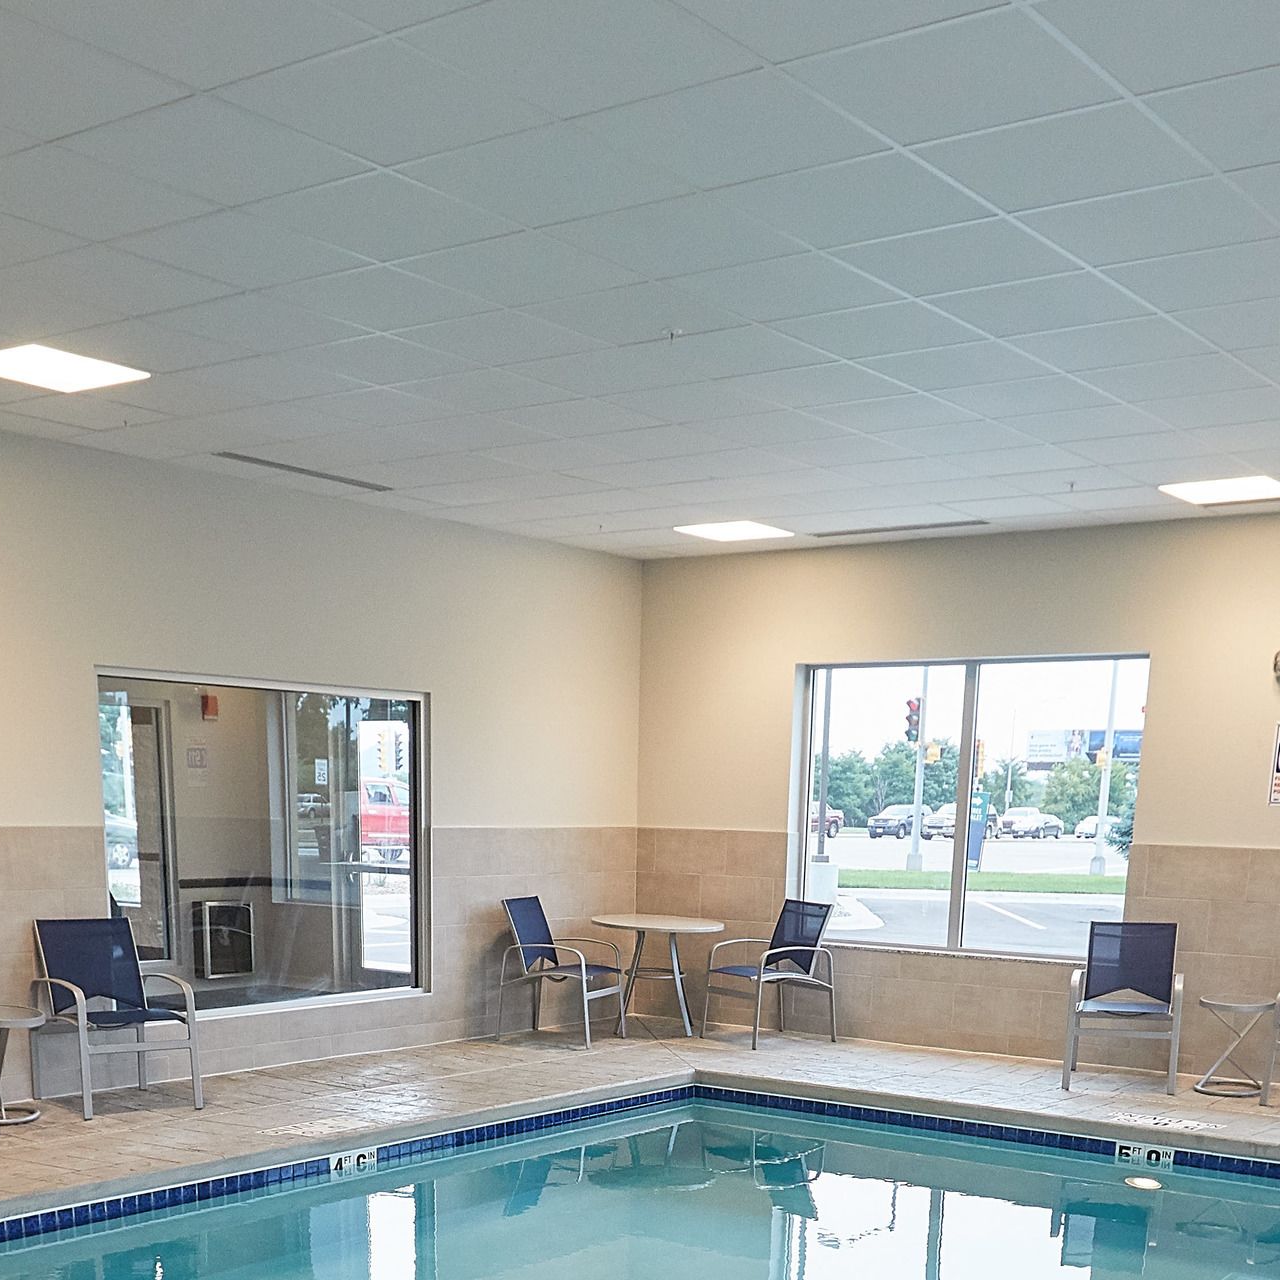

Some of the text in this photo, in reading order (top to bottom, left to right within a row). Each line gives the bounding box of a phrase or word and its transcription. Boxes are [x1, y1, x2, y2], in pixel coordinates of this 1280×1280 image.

[343, 1155, 352, 1164] FT
[367, 1151, 376, 1160] IN
[1132, 1147, 1142, 1155] FT
[1162, 1151, 1172, 1160] IN
